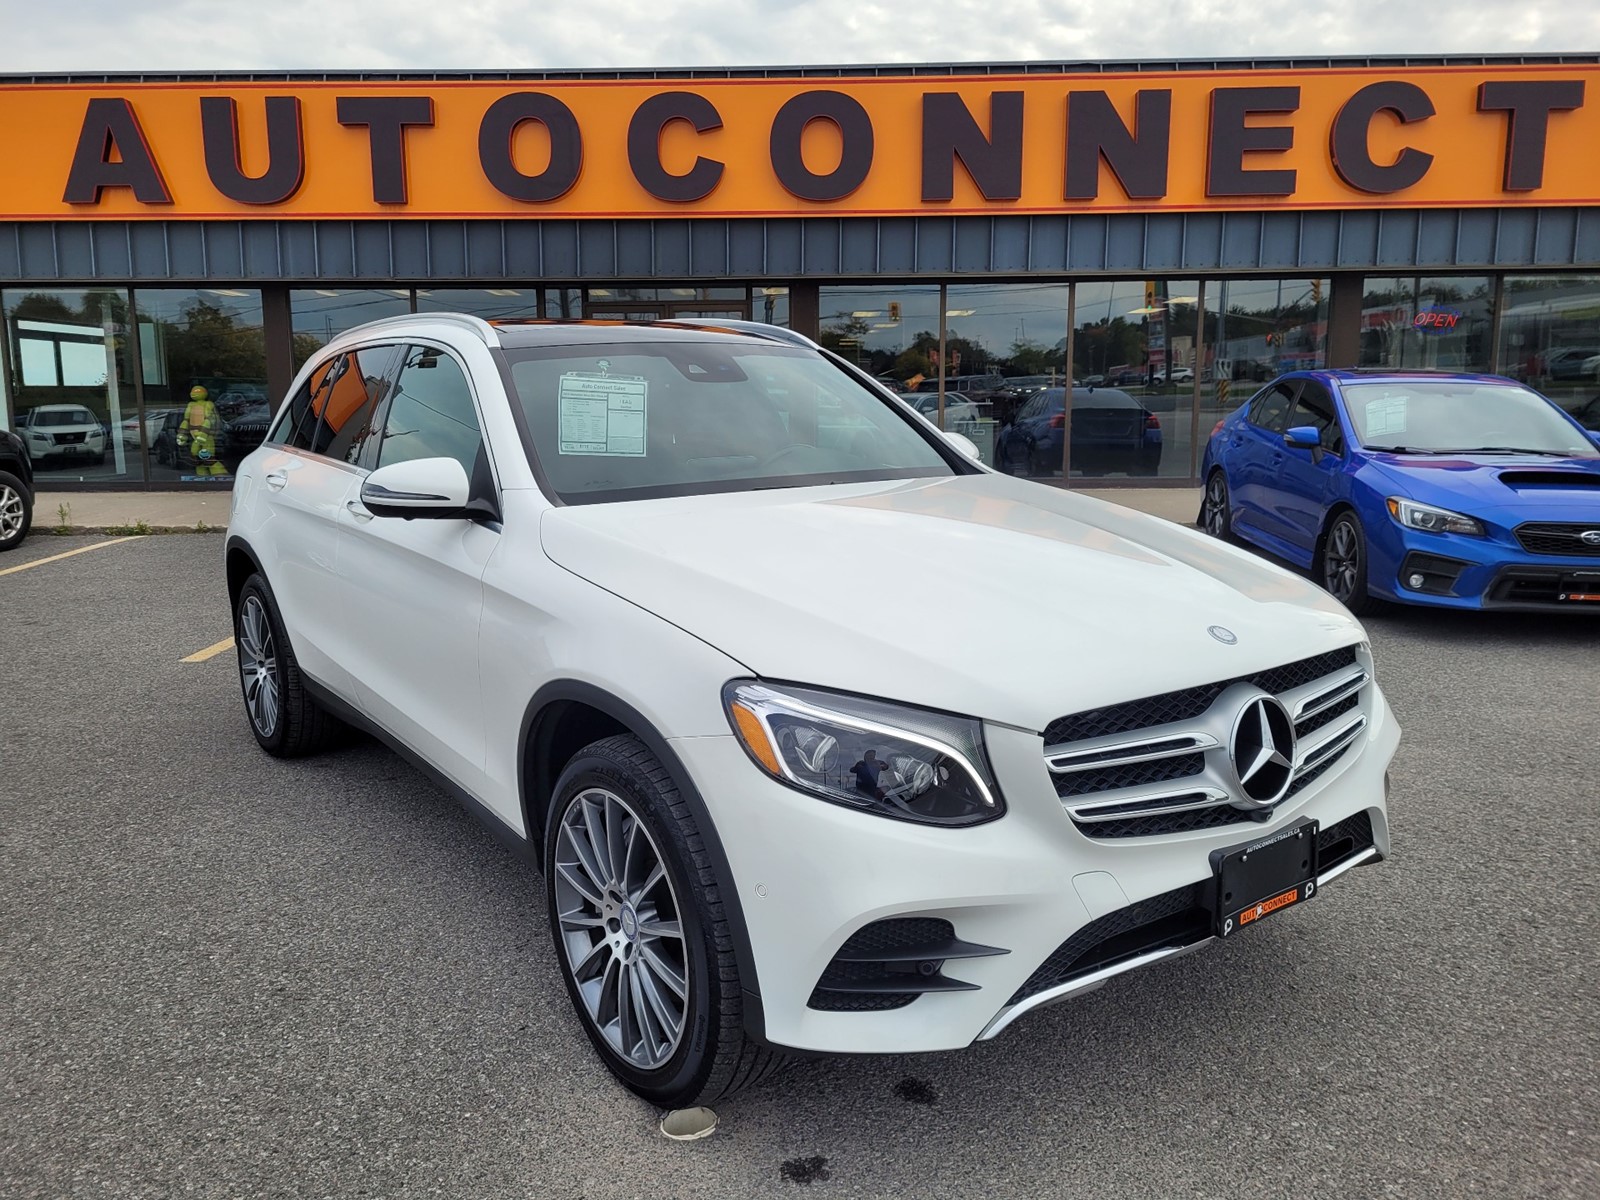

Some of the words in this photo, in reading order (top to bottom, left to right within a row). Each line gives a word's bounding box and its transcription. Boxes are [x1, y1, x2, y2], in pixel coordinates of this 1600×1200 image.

[62, 79, 1585, 206] AUTOCONNECT
[1414, 312, 1459, 327] OPEN
[1246, 827, 1300, 854] AUTOCONNECTSALES.CA
